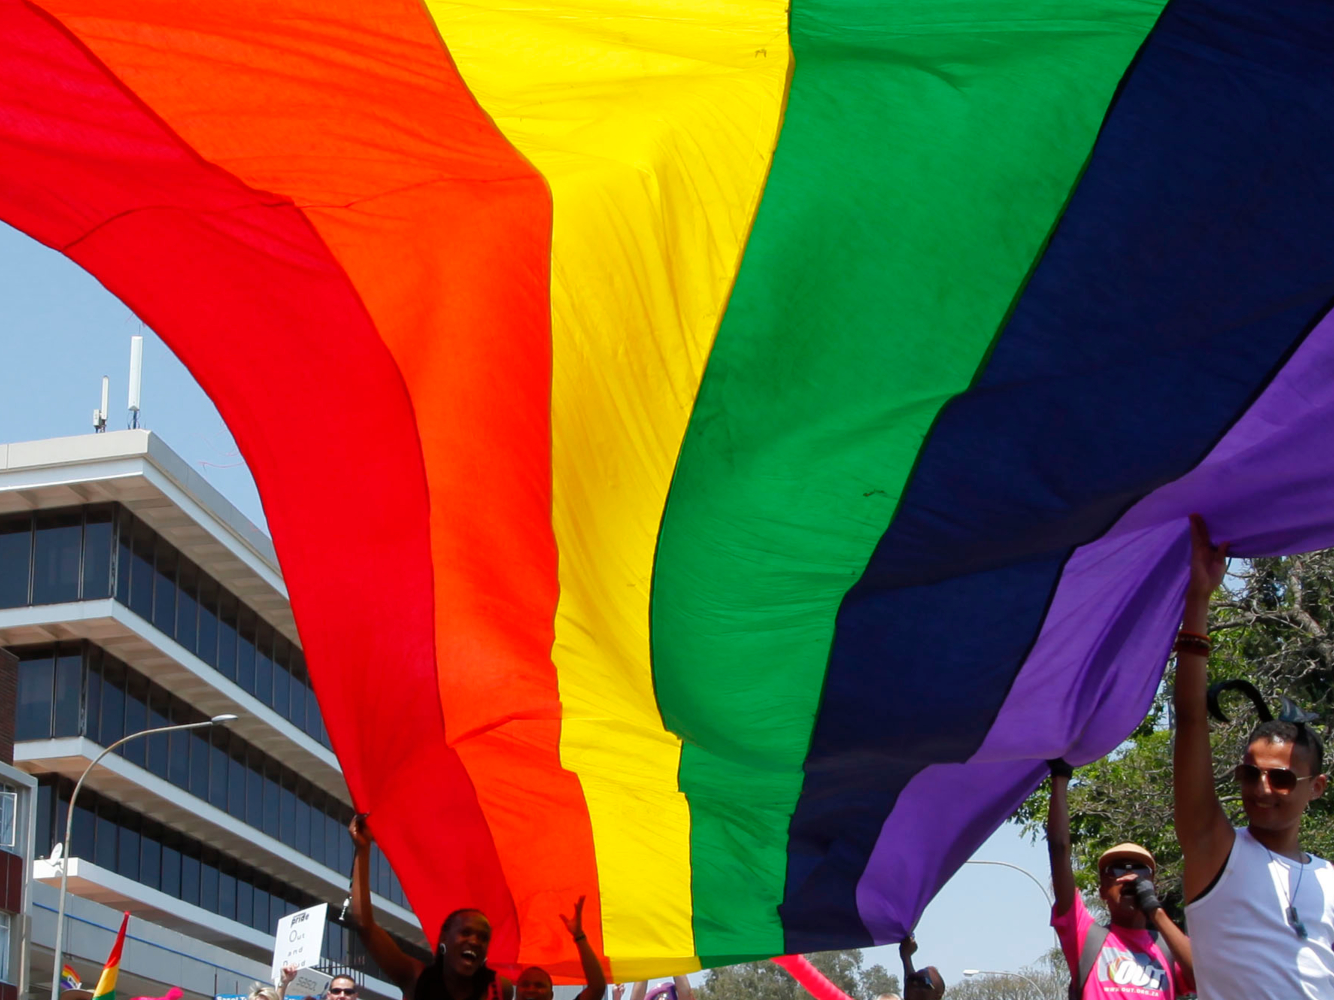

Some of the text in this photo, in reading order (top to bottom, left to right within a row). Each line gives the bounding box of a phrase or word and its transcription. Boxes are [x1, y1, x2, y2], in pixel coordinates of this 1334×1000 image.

[290, 912, 309, 927] pride
[289, 929, 305, 943] Out
[1114, 960, 1166, 989] OUT
